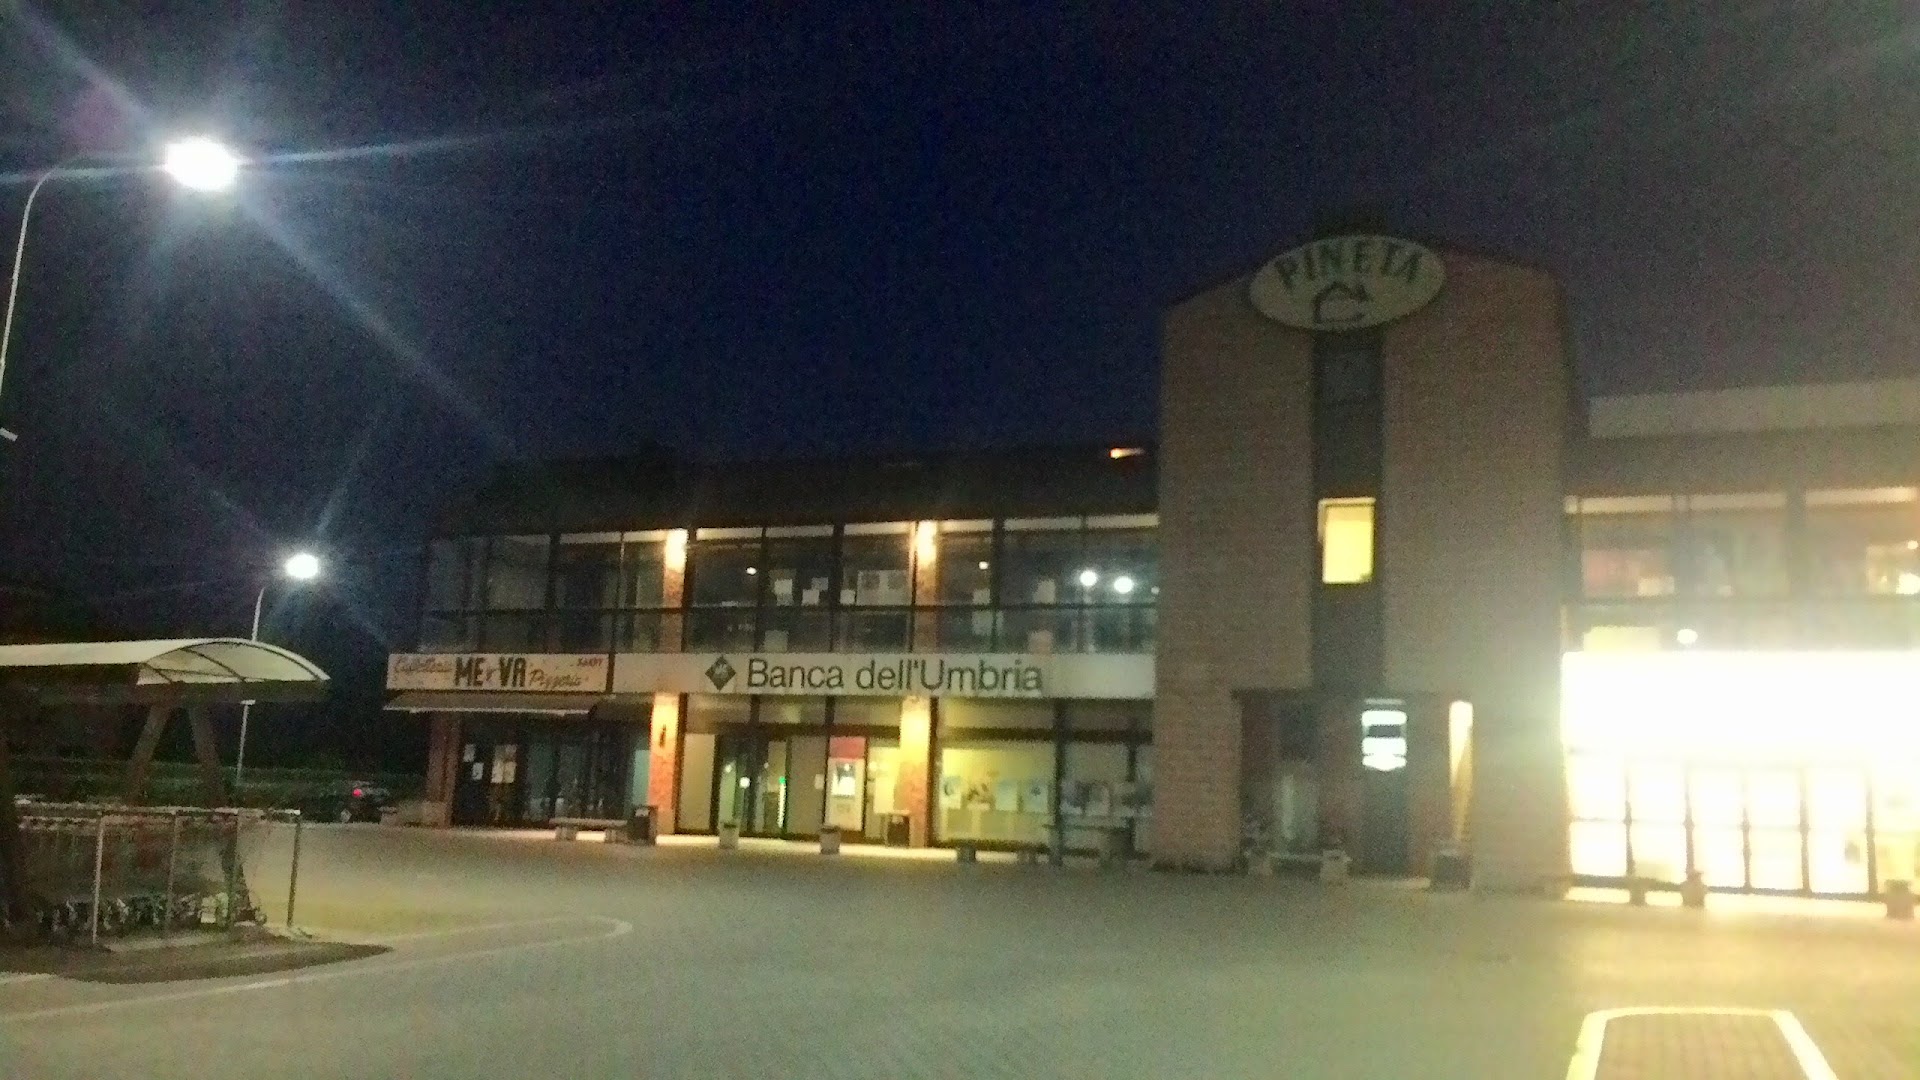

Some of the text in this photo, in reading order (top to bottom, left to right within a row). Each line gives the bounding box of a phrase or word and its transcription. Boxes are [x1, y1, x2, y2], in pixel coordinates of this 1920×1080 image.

[1273, 239, 1422, 290] PINETA
[747, 658, 1043, 692] Banca dell'Umbria
